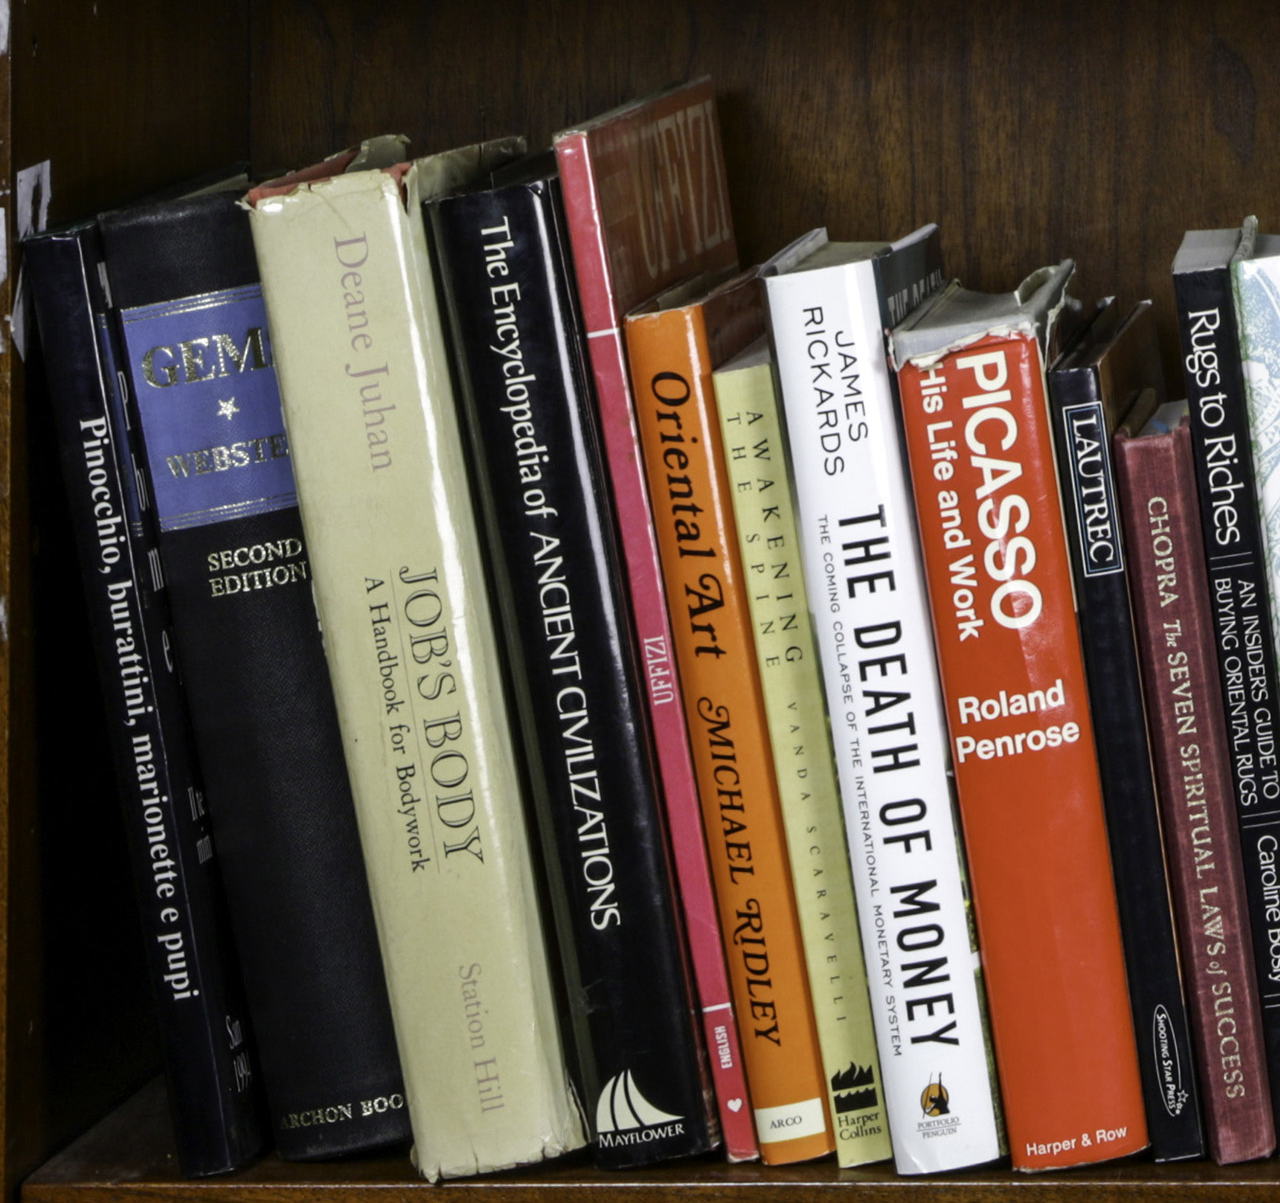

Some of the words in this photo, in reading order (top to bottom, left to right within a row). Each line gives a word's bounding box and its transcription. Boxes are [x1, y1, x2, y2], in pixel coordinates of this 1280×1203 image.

[479, 215, 514, 277] The
[334, 234, 373, 354] Deane
[489, 283, 547, 483] Encyclopedia
[1185, 307, 1221, 388] Rugs
[344, 358, 394, 473] Juhan
[802, 307, 844, 477] RICKARDS
[832, 330, 868, 443] JAMES
[918, 361, 946, 413] His
[1199, 393, 1228, 427] to
[651, 371, 718, 560] Oriental
[926, 420, 958, 481] Life
[79, 414, 126, 574] Pinocchio,
[523, 486, 558, 520] of
[937, 488, 969, 549] and
[955, 350, 1043, 630] PICASSO
[1072, 417, 1115, 563] LAUTREC
[1204, 433, 1243, 545] Riches
[208, 538, 303, 572] SECOND
[728, 411, 752, 493] THE
[745, 533, 781, 668] SPINE
[746, 410, 804, 663] AWAKENING
[817, 513, 831, 544] THE
[838, 503, 897, 599] THE
[1147, 496, 1180, 607] CHOPRA
[209, 561, 307, 597] EDITION
[364, 576, 384, 596] A
[529, 528, 583, 679] ANCIENT
[822, 552, 841, 613] COMING
[947, 552, 984, 641] Work
[1214, 578, 1239, 650] BUYING
[1238, 580, 1257, 608] AN
[400, 563, 455, 700] JOB'S
[684, 573, 727, 659] Art
[1162, 618, 1181, 649] The
[107, 578, 153, 727] burattini,
[368, 601, 405, 717] Handbook
[644, 636, 674, 707] UFFIZI
[831, 619, 854, 705] COLLAPSE
[846, 711, 858, 732] OF
[853, 619, 920, 774] DEATH
[958, 680, 1065, 725] Roland
[1166, 653, 1198, 735] SEVEN
[1224, 656, 1251, 750] ORIENTAL
[388, 724, 410, 757] for
[848, 737, 862, 769] THE
[955, 719, 1081, 765] Penrose
[1254, 707, 1276, 766] GUIDE
[131, 733, 176, 897] marionette
[424, 712, 484, 865] BODY
[556, 685, 621, 932] CIVILIZATIONS
[698, 697, 756, 886] MICHAEL
[1179, 743, 1218, 880] SPIRITUAL
[1237, 754, 1258, 807] RUGS
[1264, 771, 1280, 800] TO
[394, 762, 428, 875] Bodywork
[854, 774, 881, 898] INTERNATIONAL
[879, 798, 933, 855] OF
[787, 700, 811, 802] VANDA
[806, 824, 847, 1023] SCARAVELLI
[160, 904, 179, 924] e
[872, 903, 893, 988] MONETARY
[1197, 887, 1227, 955] LAWS
[157, 931, 200, 1002] pupi
[734, 897, 781, 1047] RIDLEY
[890, 879, 960, 1051] MONEY
[1208, 959, 1226, 976] of
[458, 962, 489, 1046] Station
[475, 1058, 505, 1114] Hill
[714, 1025, 732, 1069] ENGLISH
[885, 995, 902, 1056] SYSTEM
[1155, 1012, 1169, 1058] SHOOTING
[1213, 982, 1244, 1100] SUCCESS
[1161, 1059, 1175, 1084] STAR
[1166, 1084, 1178, 1110] PRESS
[598, 1120, 685, 1148] MAYFLOWER
[770, 1115, 803, 1130] ARCO
[837, 1110, 880, 1130] Harper
[839, 1123, 882, 1142] Collins
[917, 1116, 959, 1129] PORTFOLIO
[922, 1127, 957, 1139] PENGUIN
[1025, 1132, 1077, 1158] Harper
[1081, 1134, 1091, 1148] &
[1095, 1125, 1129, 1144] Row
